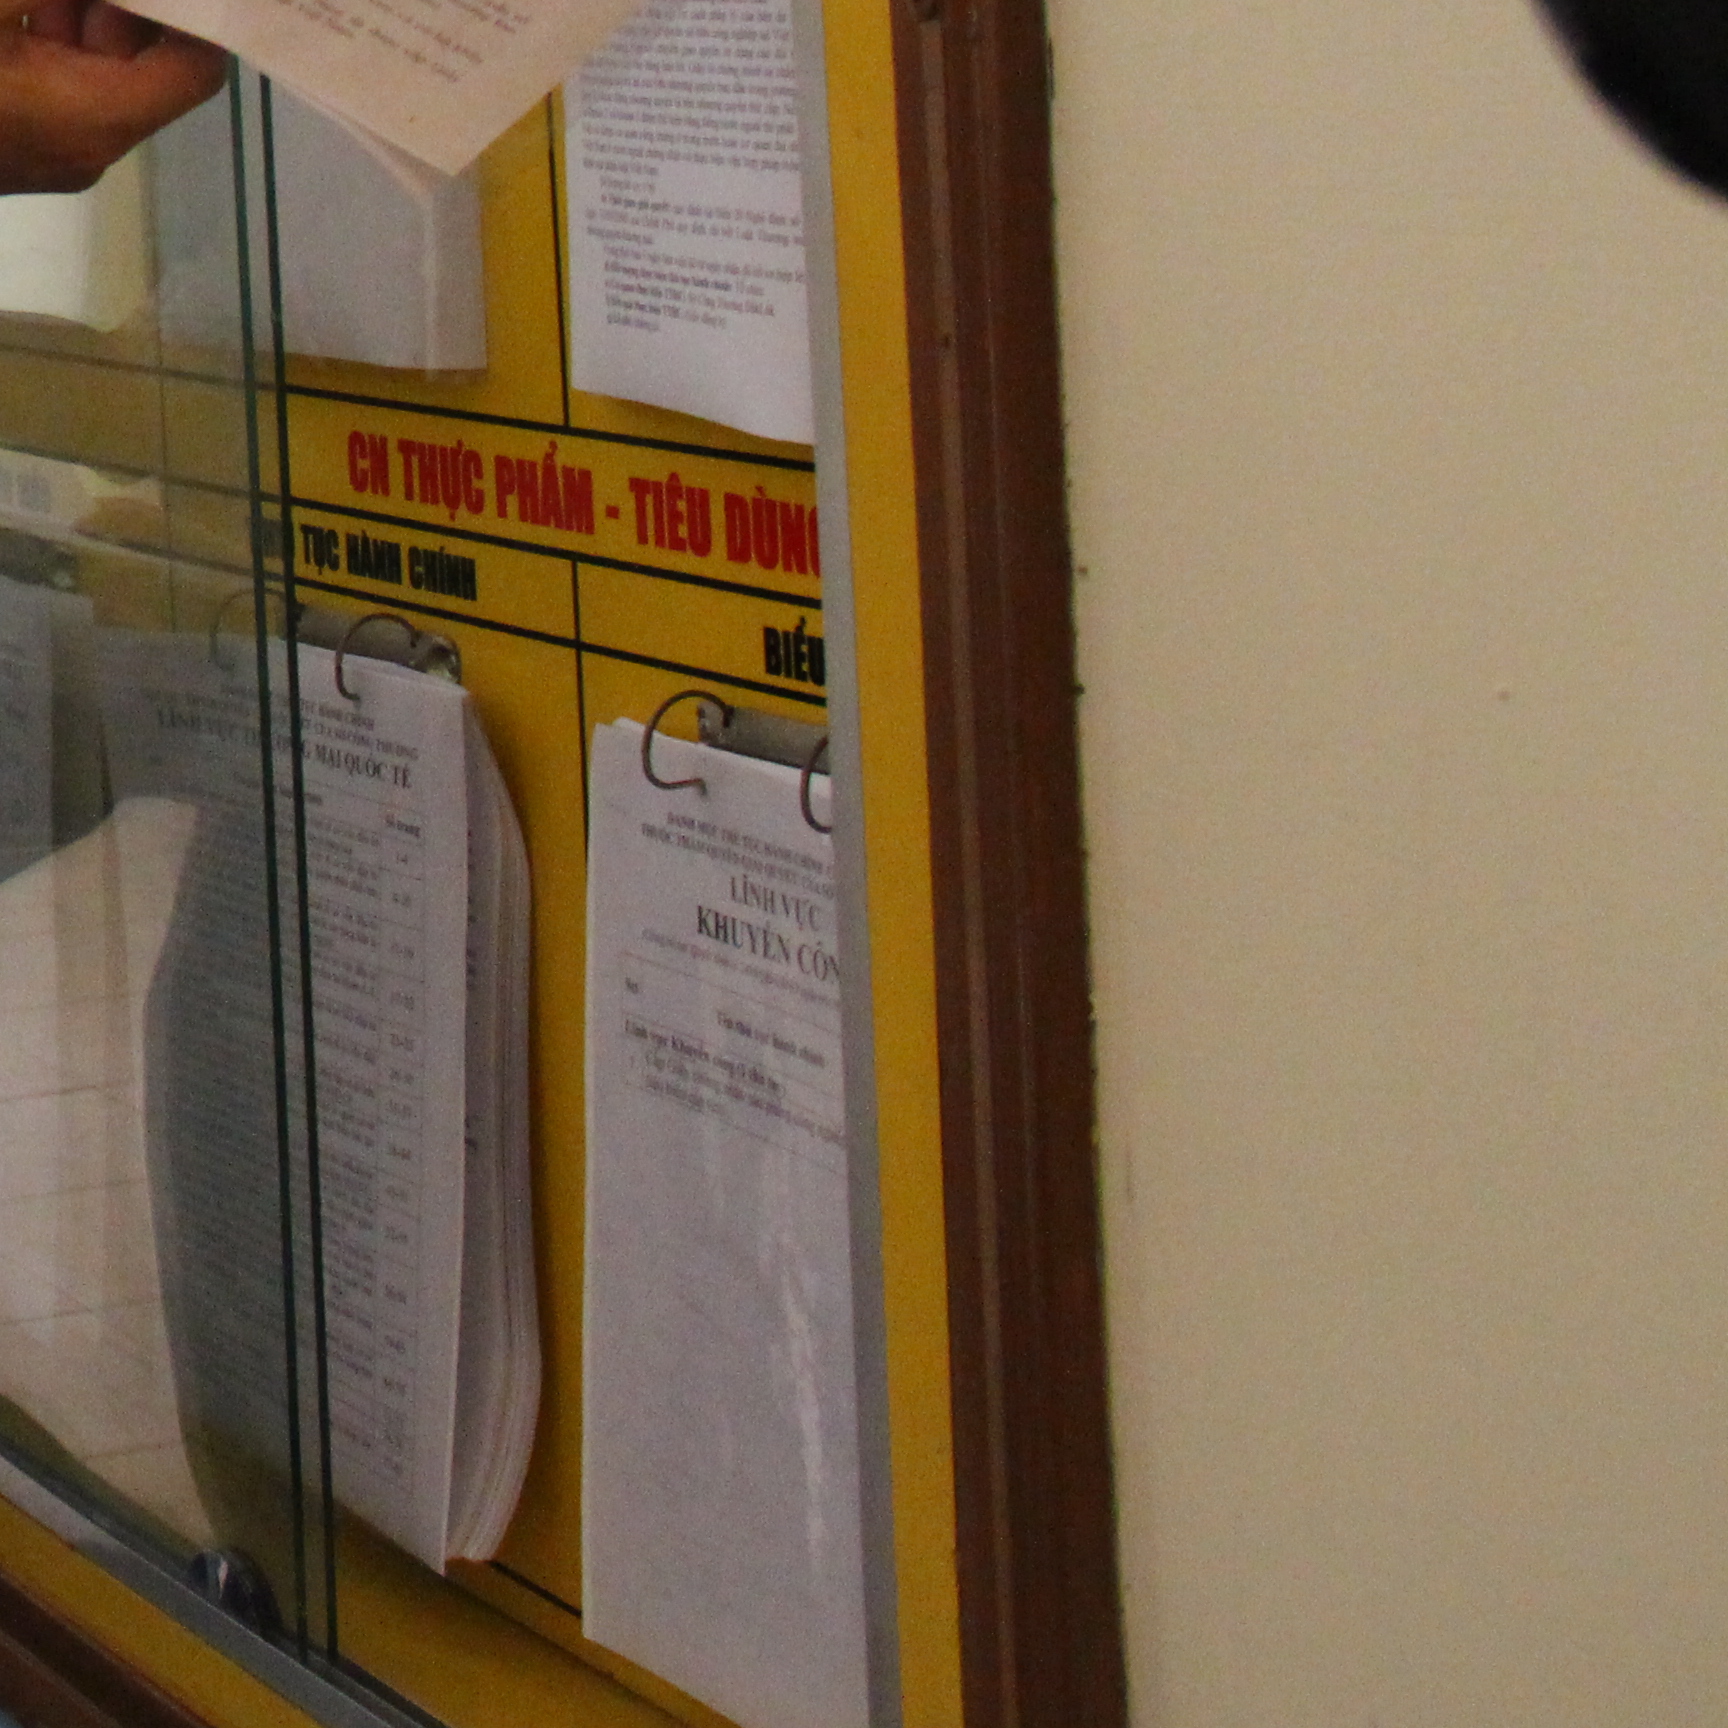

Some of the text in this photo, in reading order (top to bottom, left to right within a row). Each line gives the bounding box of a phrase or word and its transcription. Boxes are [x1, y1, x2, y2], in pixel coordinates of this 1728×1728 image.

[348, 430, 390, 497] CN
[398, 439, 486, 521] THỰC
[495, 440, 595, 535] PHẨM
[629, 472, 712, 558] TIÊU
[300, 523, 340, 575] TỤC
[346, 529, 403, 586] HÀNH
[408, 543, 478, 602] CHÍNH
